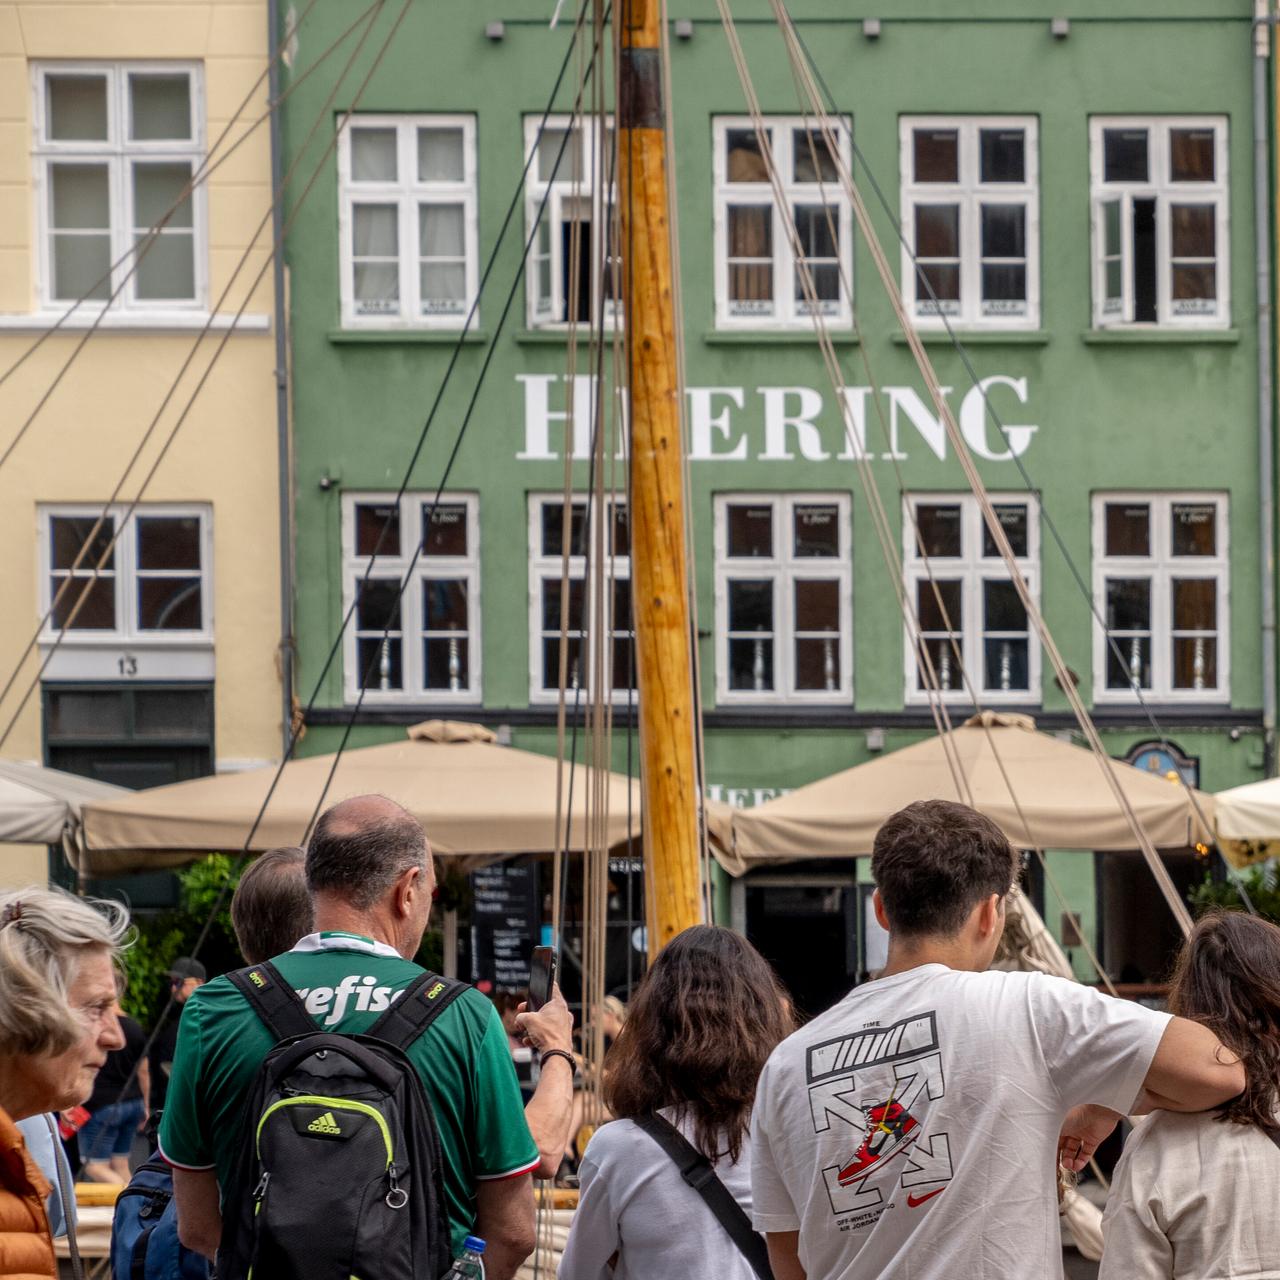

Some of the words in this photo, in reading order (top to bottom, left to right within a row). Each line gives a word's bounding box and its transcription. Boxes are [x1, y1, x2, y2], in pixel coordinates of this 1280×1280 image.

[515, 374, 1039, 461] HERING
[118, 656, 137, 675] 13
[308, 1124, 341, 1135] adidas
